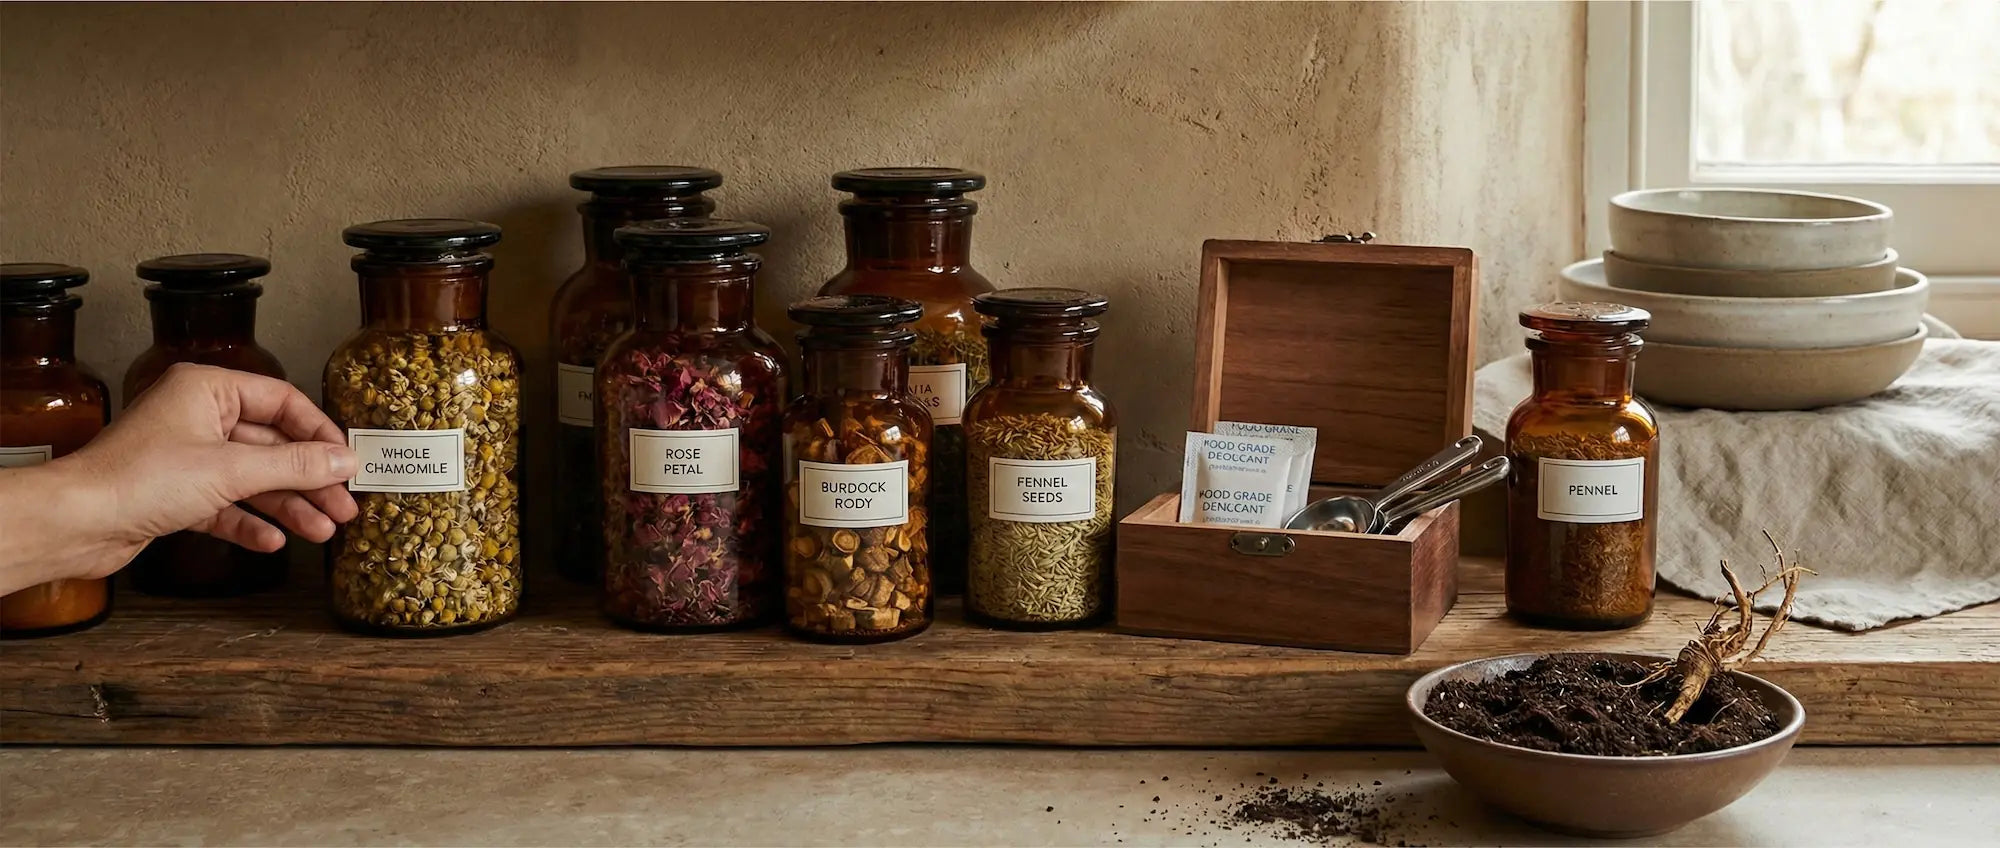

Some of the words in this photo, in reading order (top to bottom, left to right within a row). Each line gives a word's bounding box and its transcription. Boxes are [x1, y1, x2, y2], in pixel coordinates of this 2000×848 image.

[381, 447, 430, 459] WHOLE
[666, 448, 701, 460] ROSE
[1238, 442, 1276, 454] GRADE
[365, 462, 448, 474] CHAMOMILE
[664, 464, 703, 475] PETAL
[821, 481, 886, 494] BURDOCK
[1017, 476, 1068, 488] FENNEL
[1569, 484, 1618, 496] PENNEL
[1022, 491, 1063, 503] SEEDS
[1233, 491, 1272, 503] GRADE
[835, 498, 872, 509] RODY
